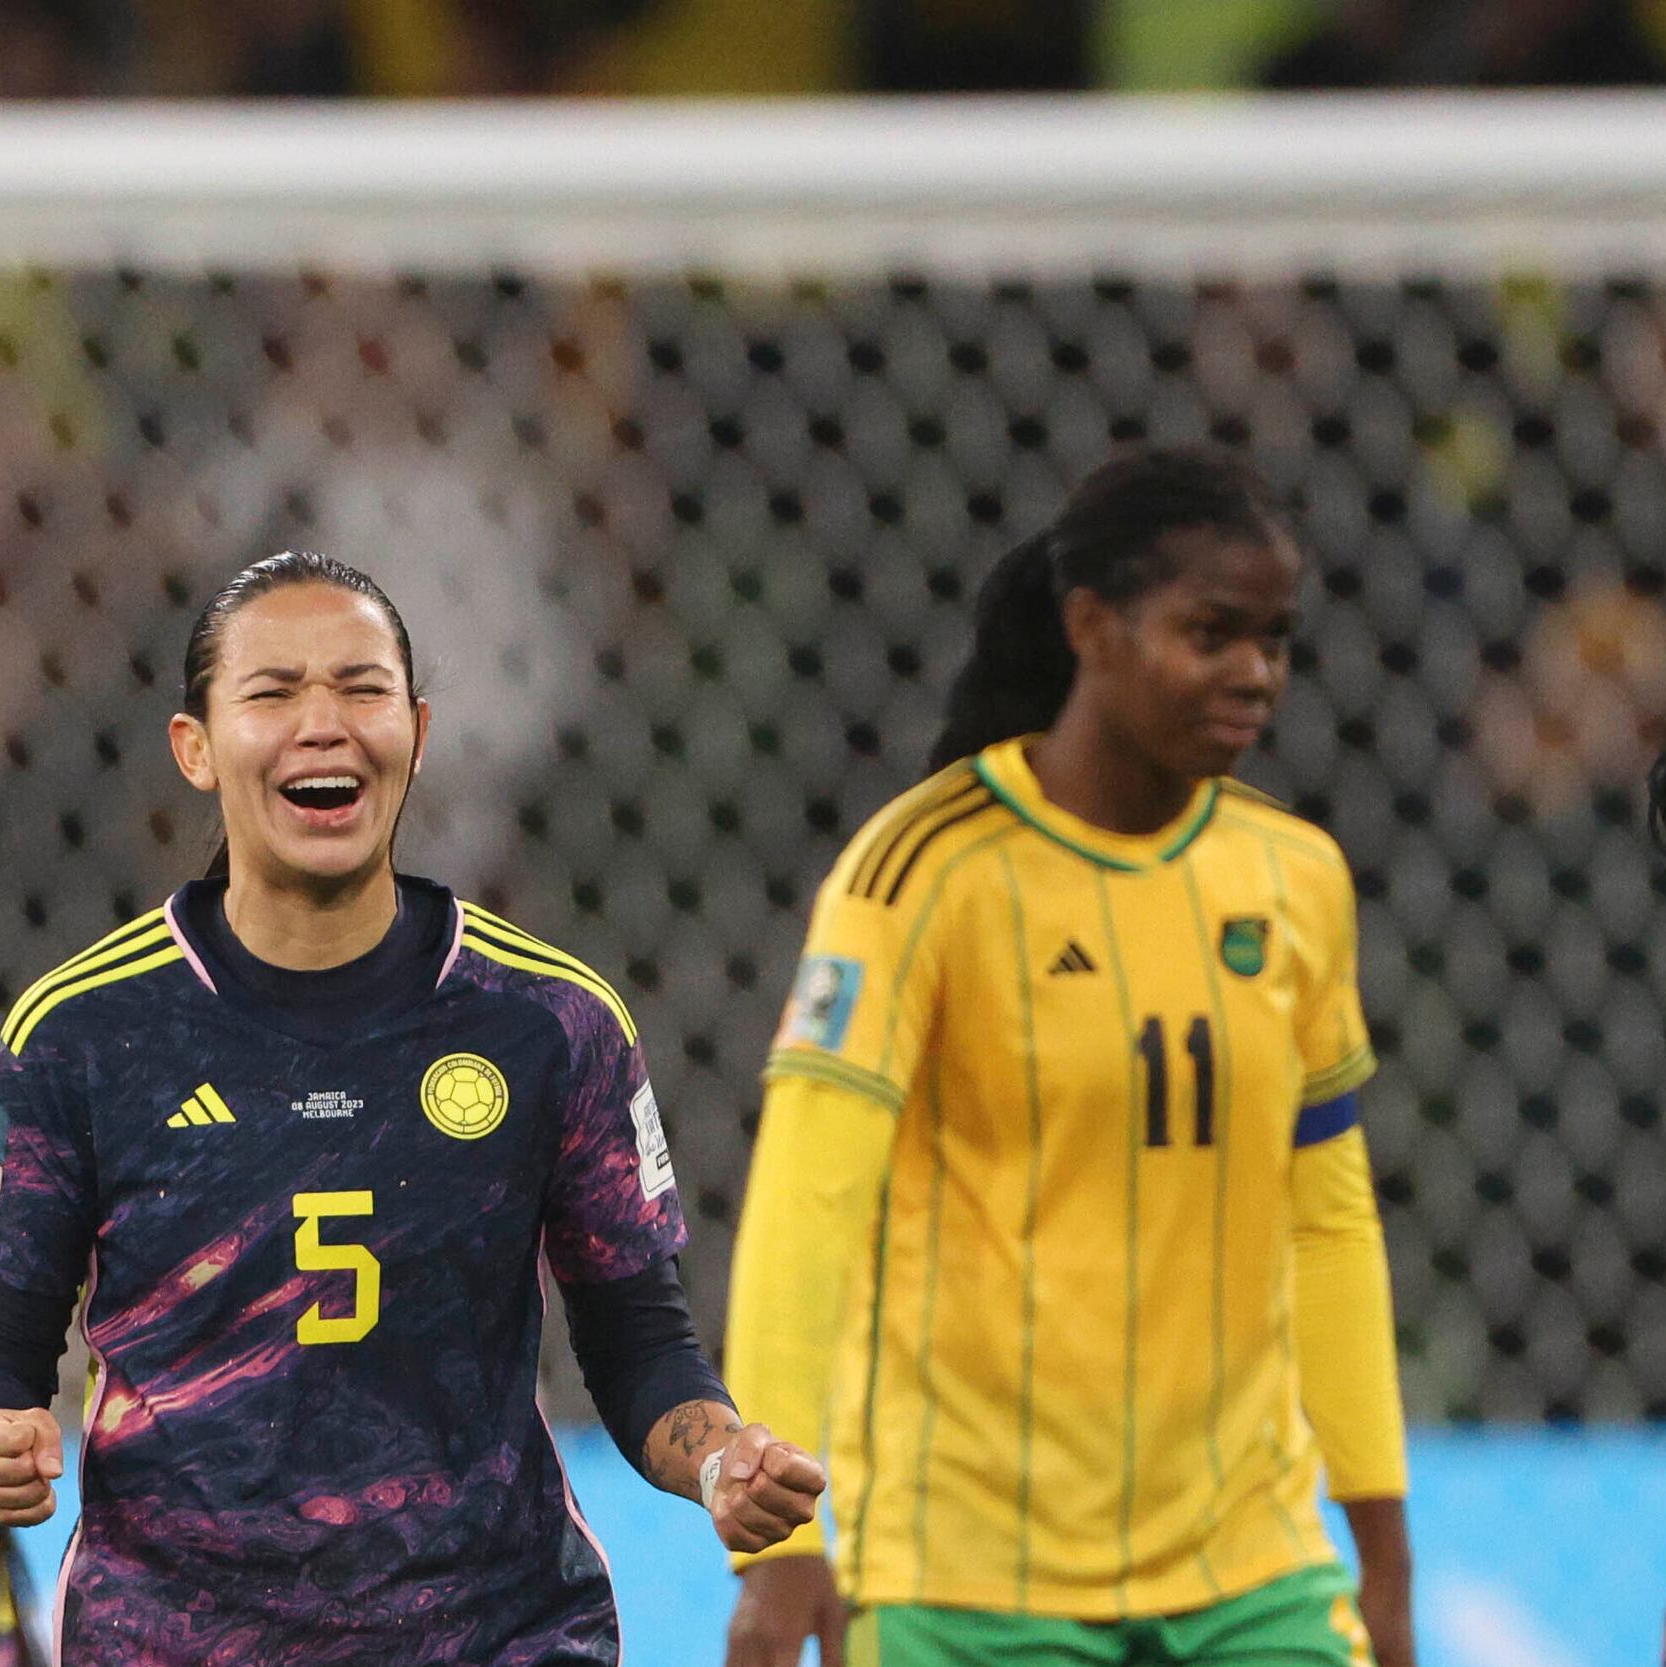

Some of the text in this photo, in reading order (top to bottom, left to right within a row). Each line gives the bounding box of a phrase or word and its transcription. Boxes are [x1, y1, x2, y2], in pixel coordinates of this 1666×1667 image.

[1137, 1014, 1216, 1147] 11
[307, 1091, 347, 1102] JAMAICA
[291, 1099, 364, 1111] 08 AUGUST 2023
[302, 1108, 355, 1119] MELBOURNE
[292, 1190, 381, 1345] 5
